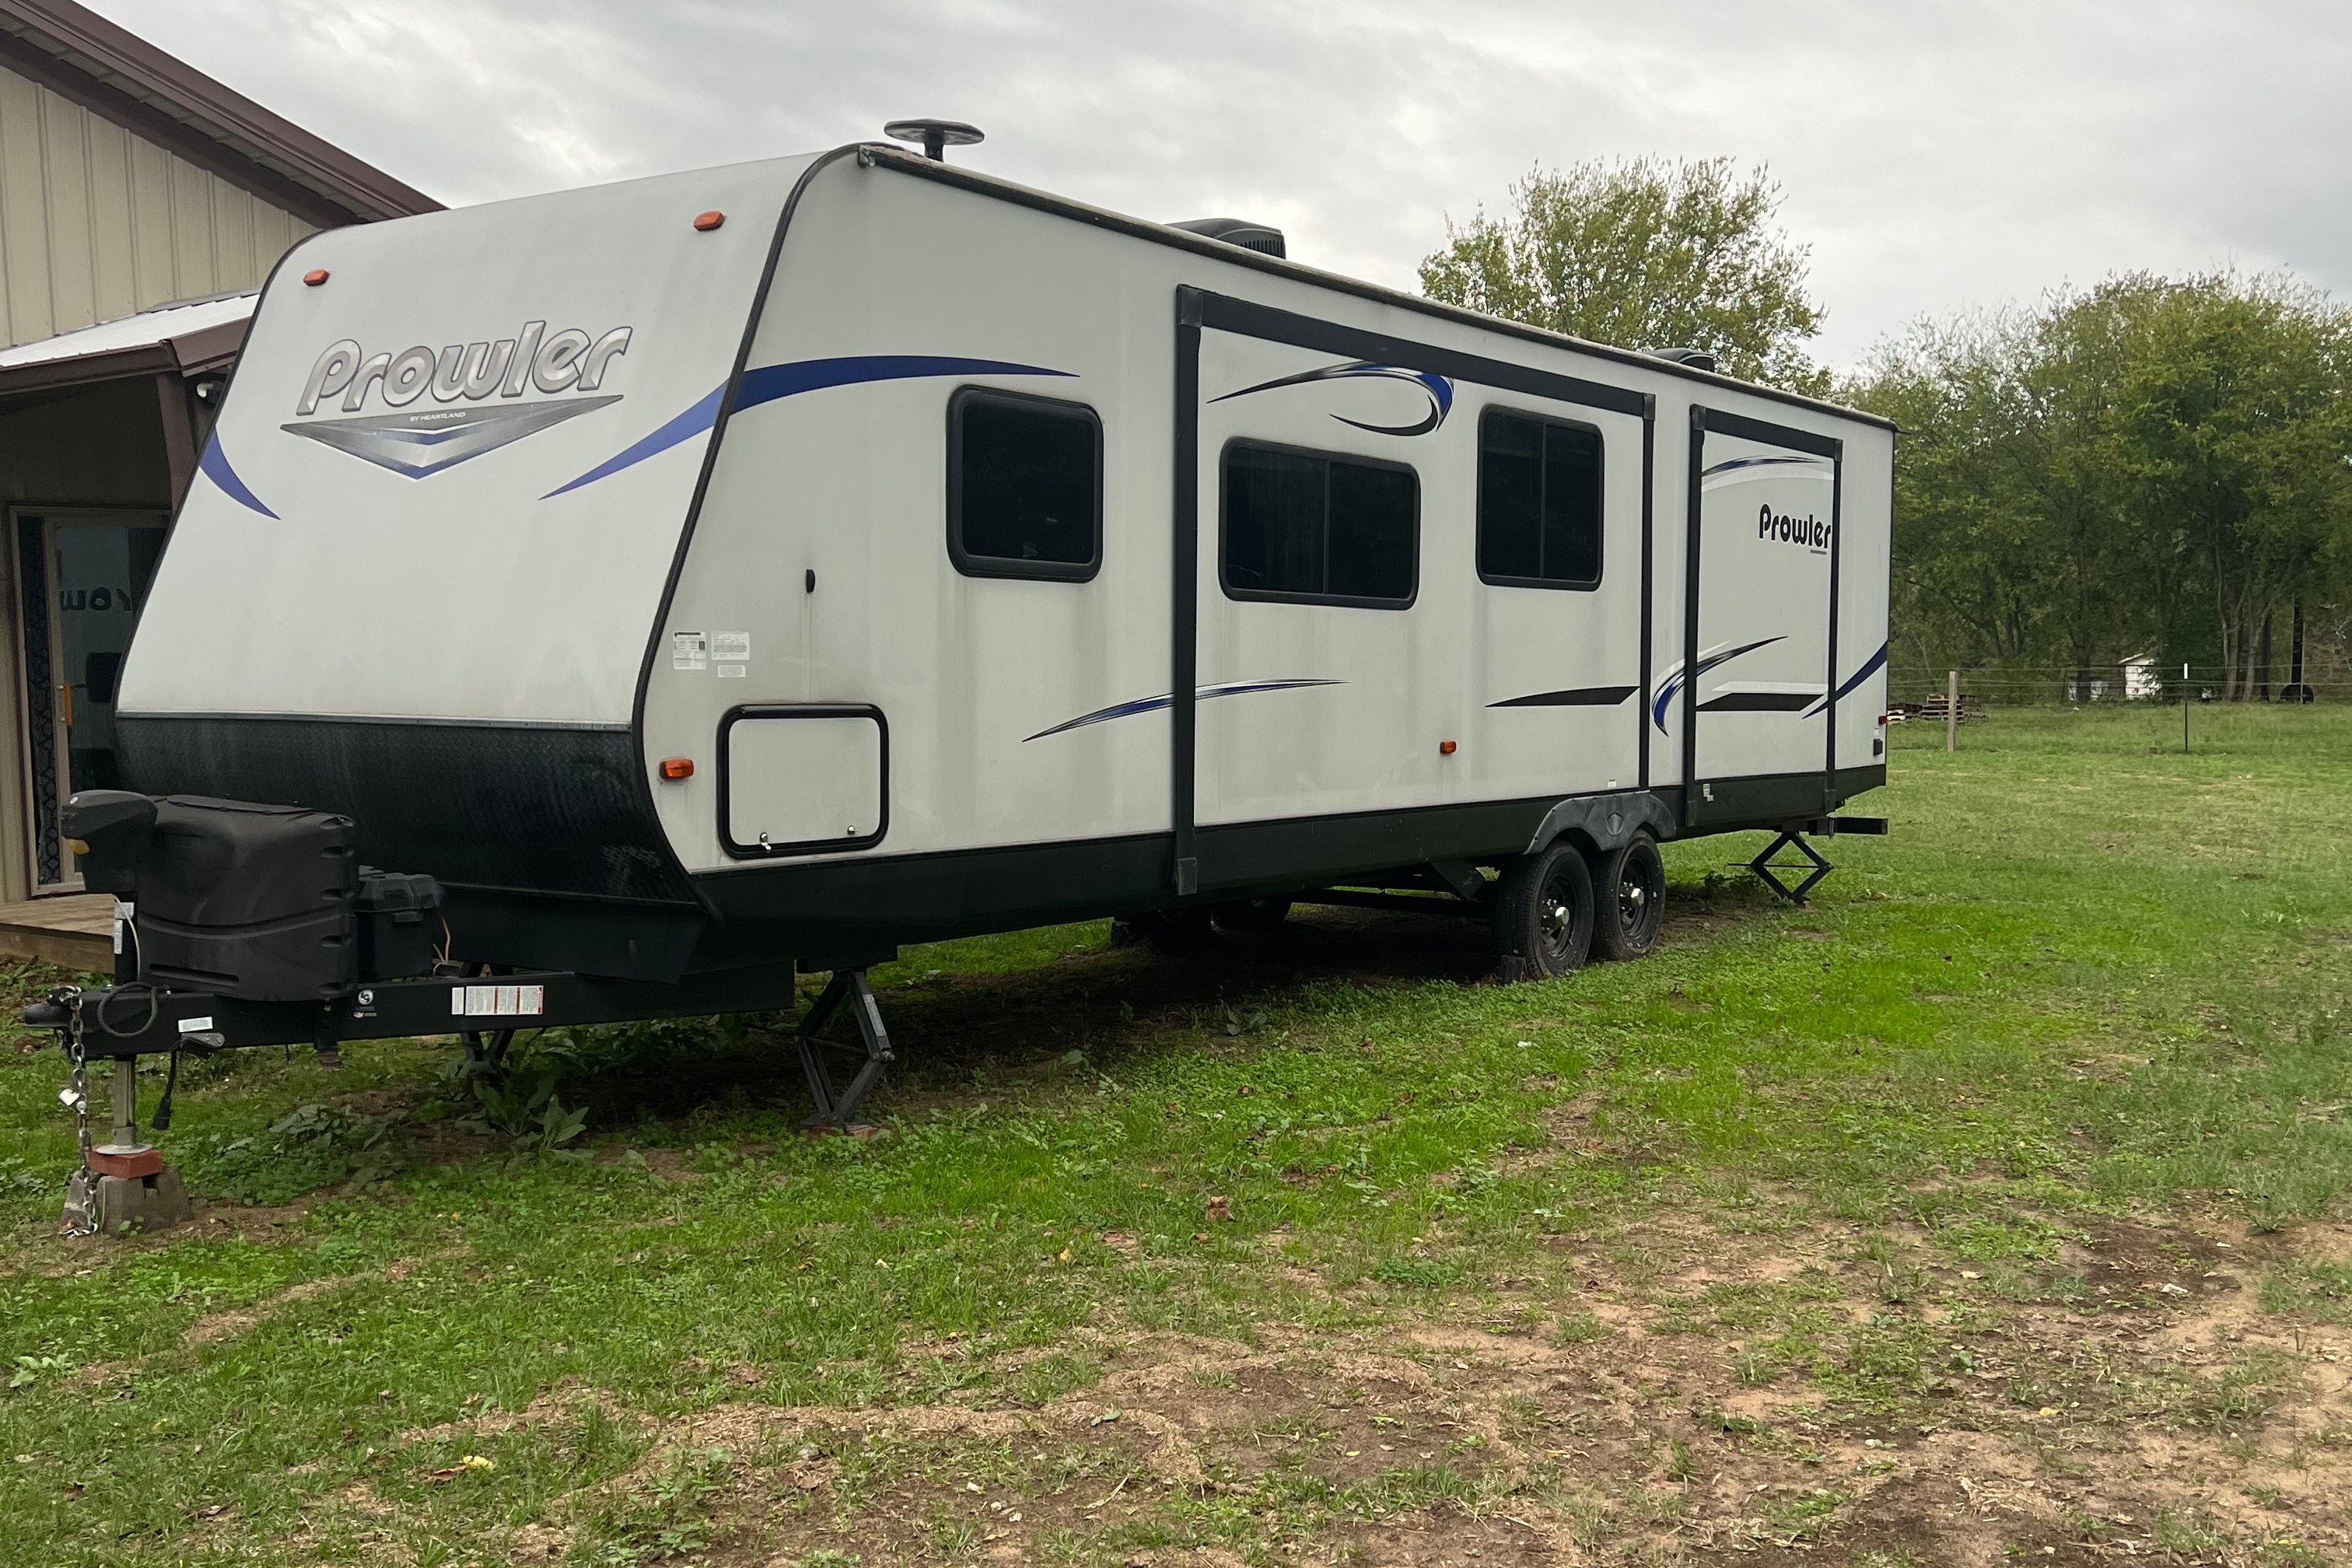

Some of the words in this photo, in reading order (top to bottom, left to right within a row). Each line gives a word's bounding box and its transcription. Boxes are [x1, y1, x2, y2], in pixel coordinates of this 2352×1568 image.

[296, 320, 633, 415] Prowler
[420, 411, 466, 421] HEARTLAND
[1759, 503, 1832, 549] Prowler
